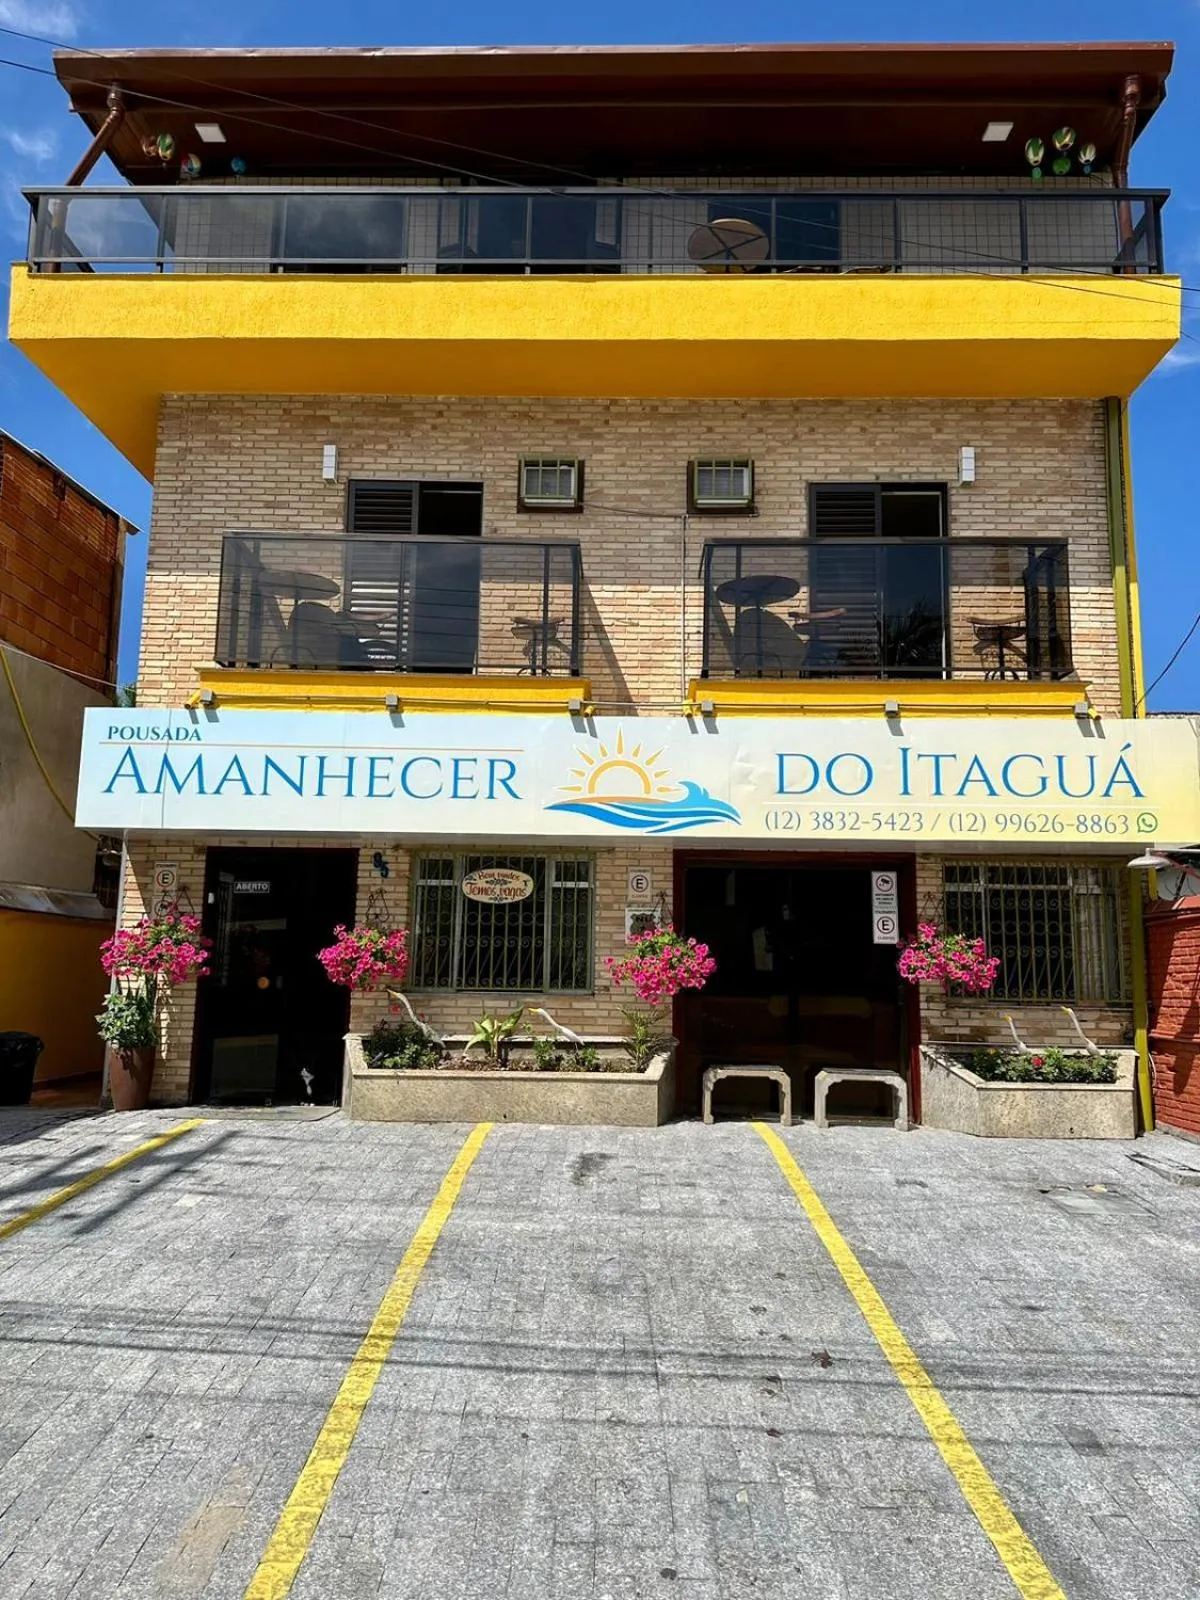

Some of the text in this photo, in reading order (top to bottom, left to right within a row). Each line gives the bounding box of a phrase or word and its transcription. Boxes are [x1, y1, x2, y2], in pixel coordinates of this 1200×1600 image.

[107, 725, 202, 741] POUSADA
[101, 745, 524, 800] AMANHECER
[776, 742, 1146, 798] DO ITAGUÁ
[765, 811, 1130, 835] (12) 3832-5423 / (12) 99626-8863
[162, 873, 170, 884] E
[636, 878, 644, 890] E
[881, 919, 890, 931] E
